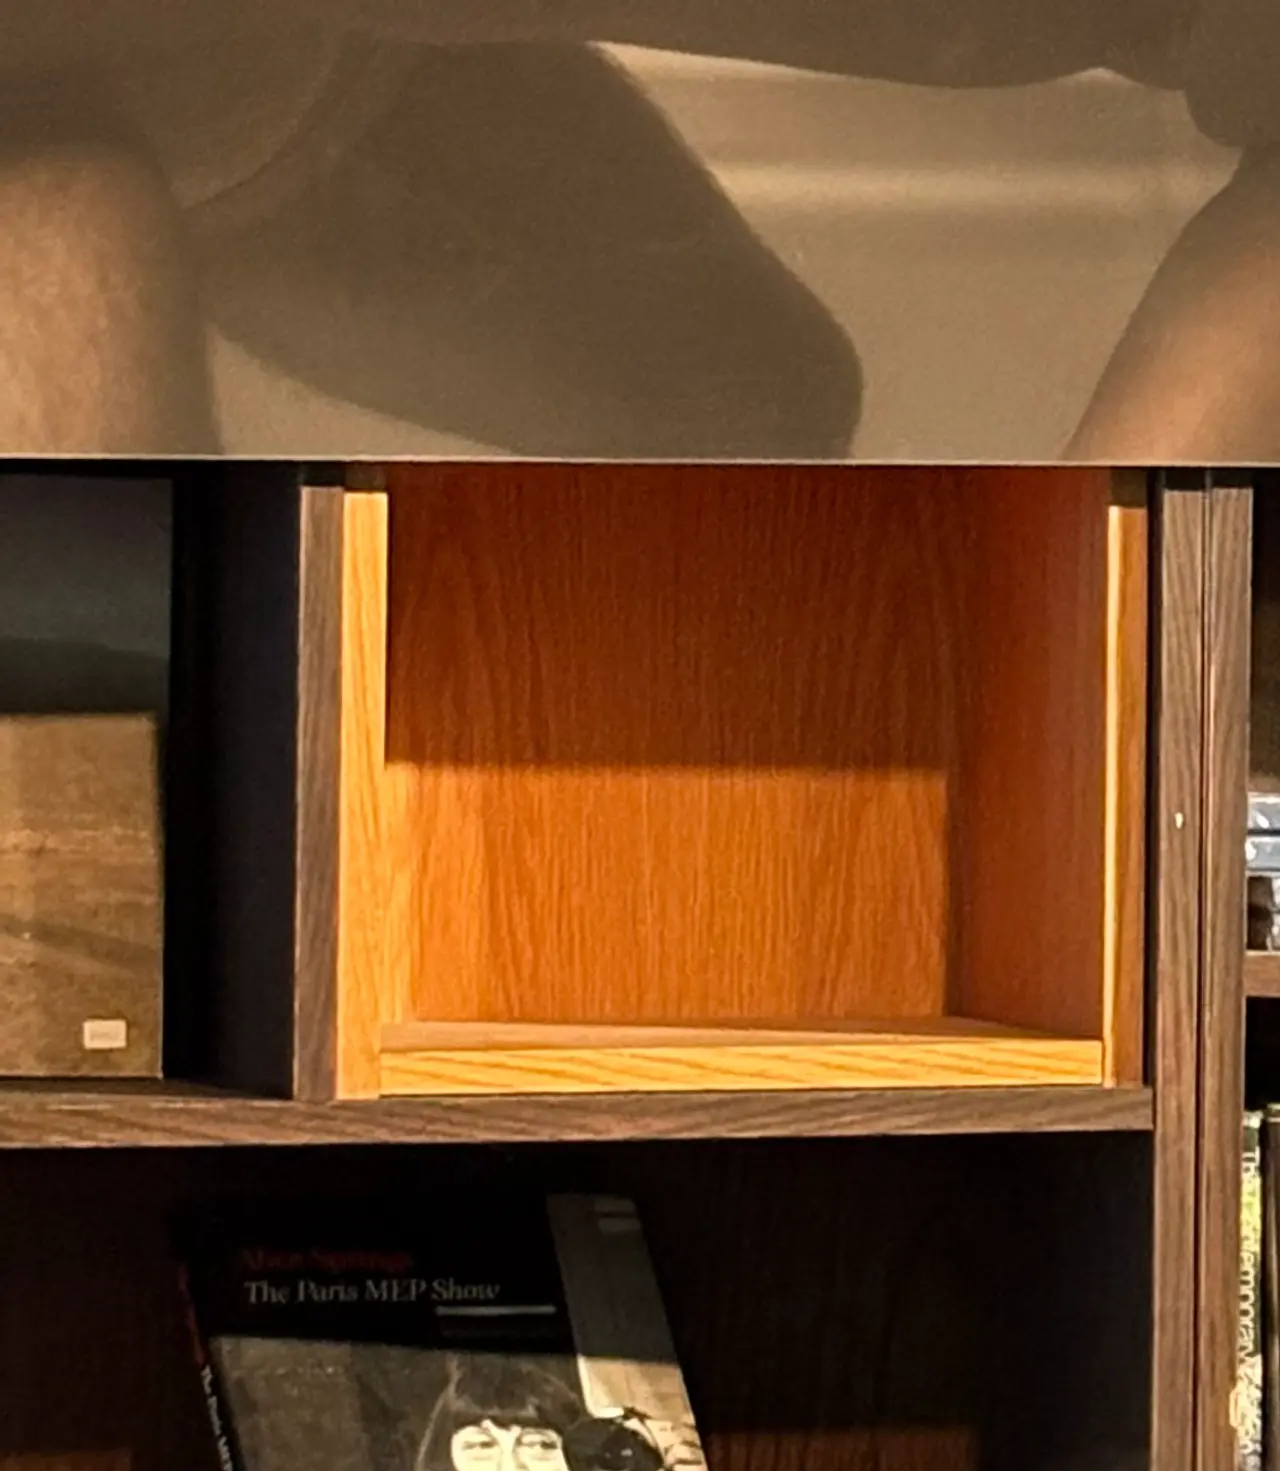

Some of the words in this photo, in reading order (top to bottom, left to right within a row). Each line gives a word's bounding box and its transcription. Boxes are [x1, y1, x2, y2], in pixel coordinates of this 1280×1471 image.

[244, 1279, 290, 1305] The
[296, 1278, 359, 1304] Paris
[365, 1277, 428, 1303] MEP
[431, 1276, 502, 1302] Show
